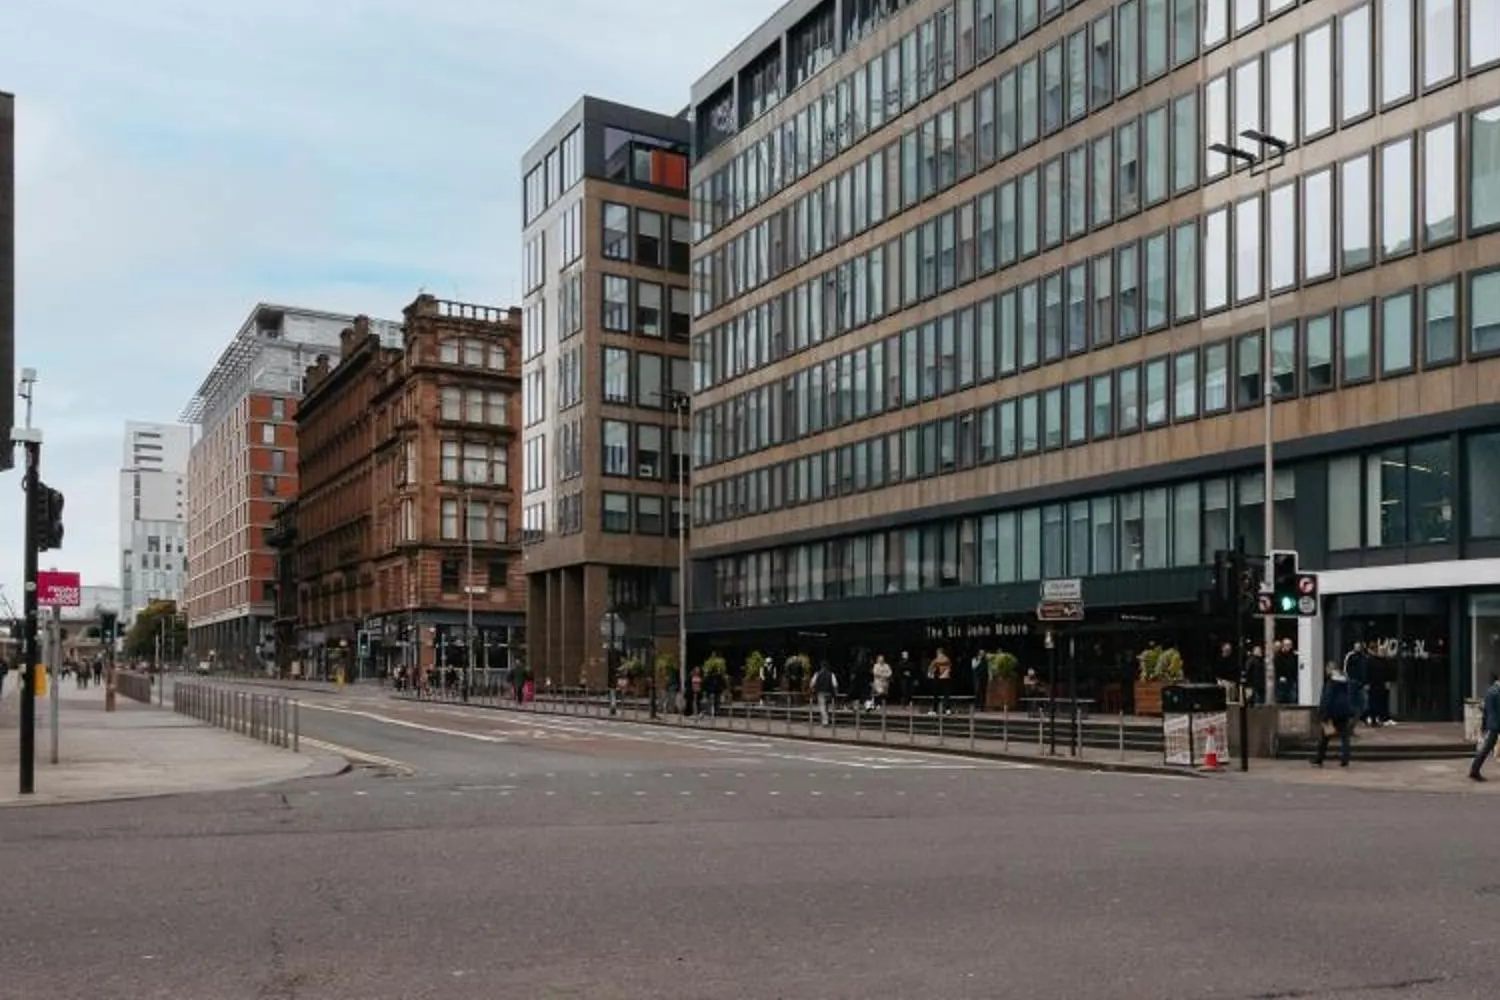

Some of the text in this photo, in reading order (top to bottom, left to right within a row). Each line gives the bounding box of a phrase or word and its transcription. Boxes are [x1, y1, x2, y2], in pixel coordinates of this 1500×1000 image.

[926, 625, 943, 639] The
[947, 624, 961, 638] Sir
[995, 623, 1029, 637] Moore
